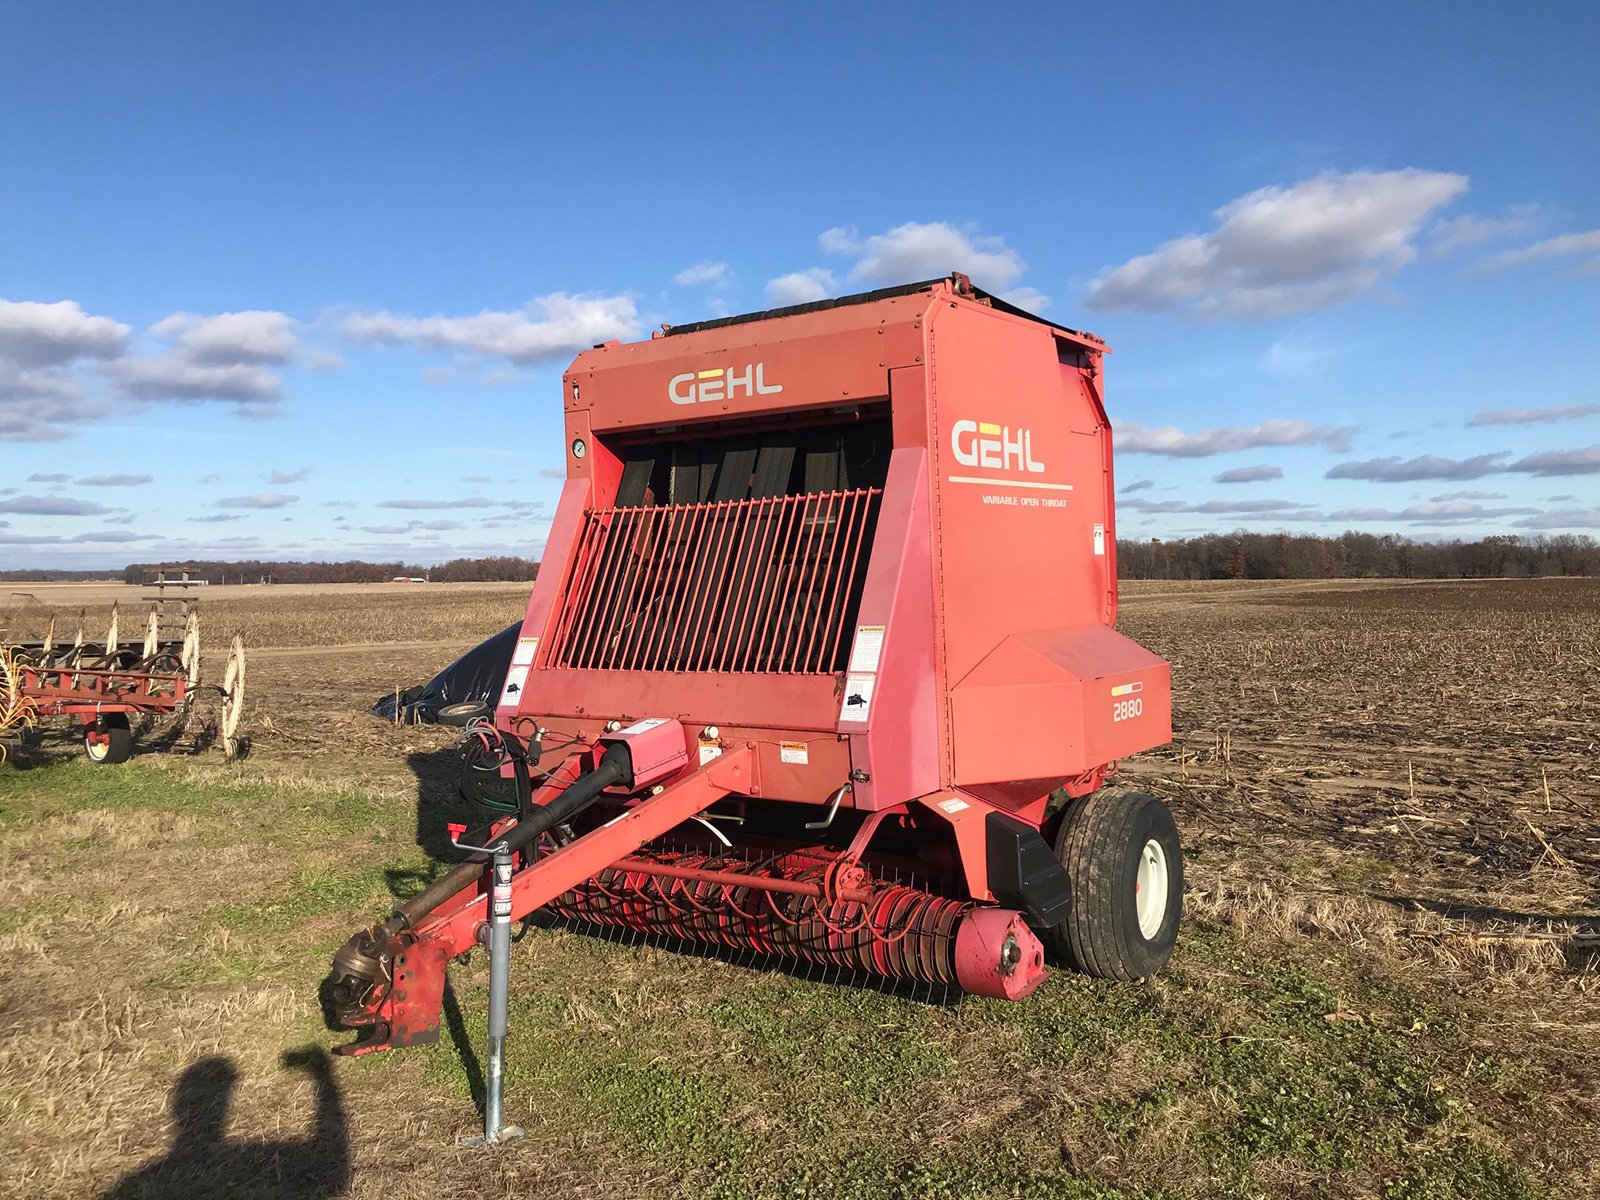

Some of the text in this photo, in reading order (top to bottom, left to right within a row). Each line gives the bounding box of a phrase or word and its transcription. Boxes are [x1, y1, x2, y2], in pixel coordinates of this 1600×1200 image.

[668, 362, 783, 405] GEHL
[951, 420, 1045, 473] GEHL
[982, 495, 1067, 508] VARIABLE OPEN THROAT
[1113, 698, 1142, 722] 2880
